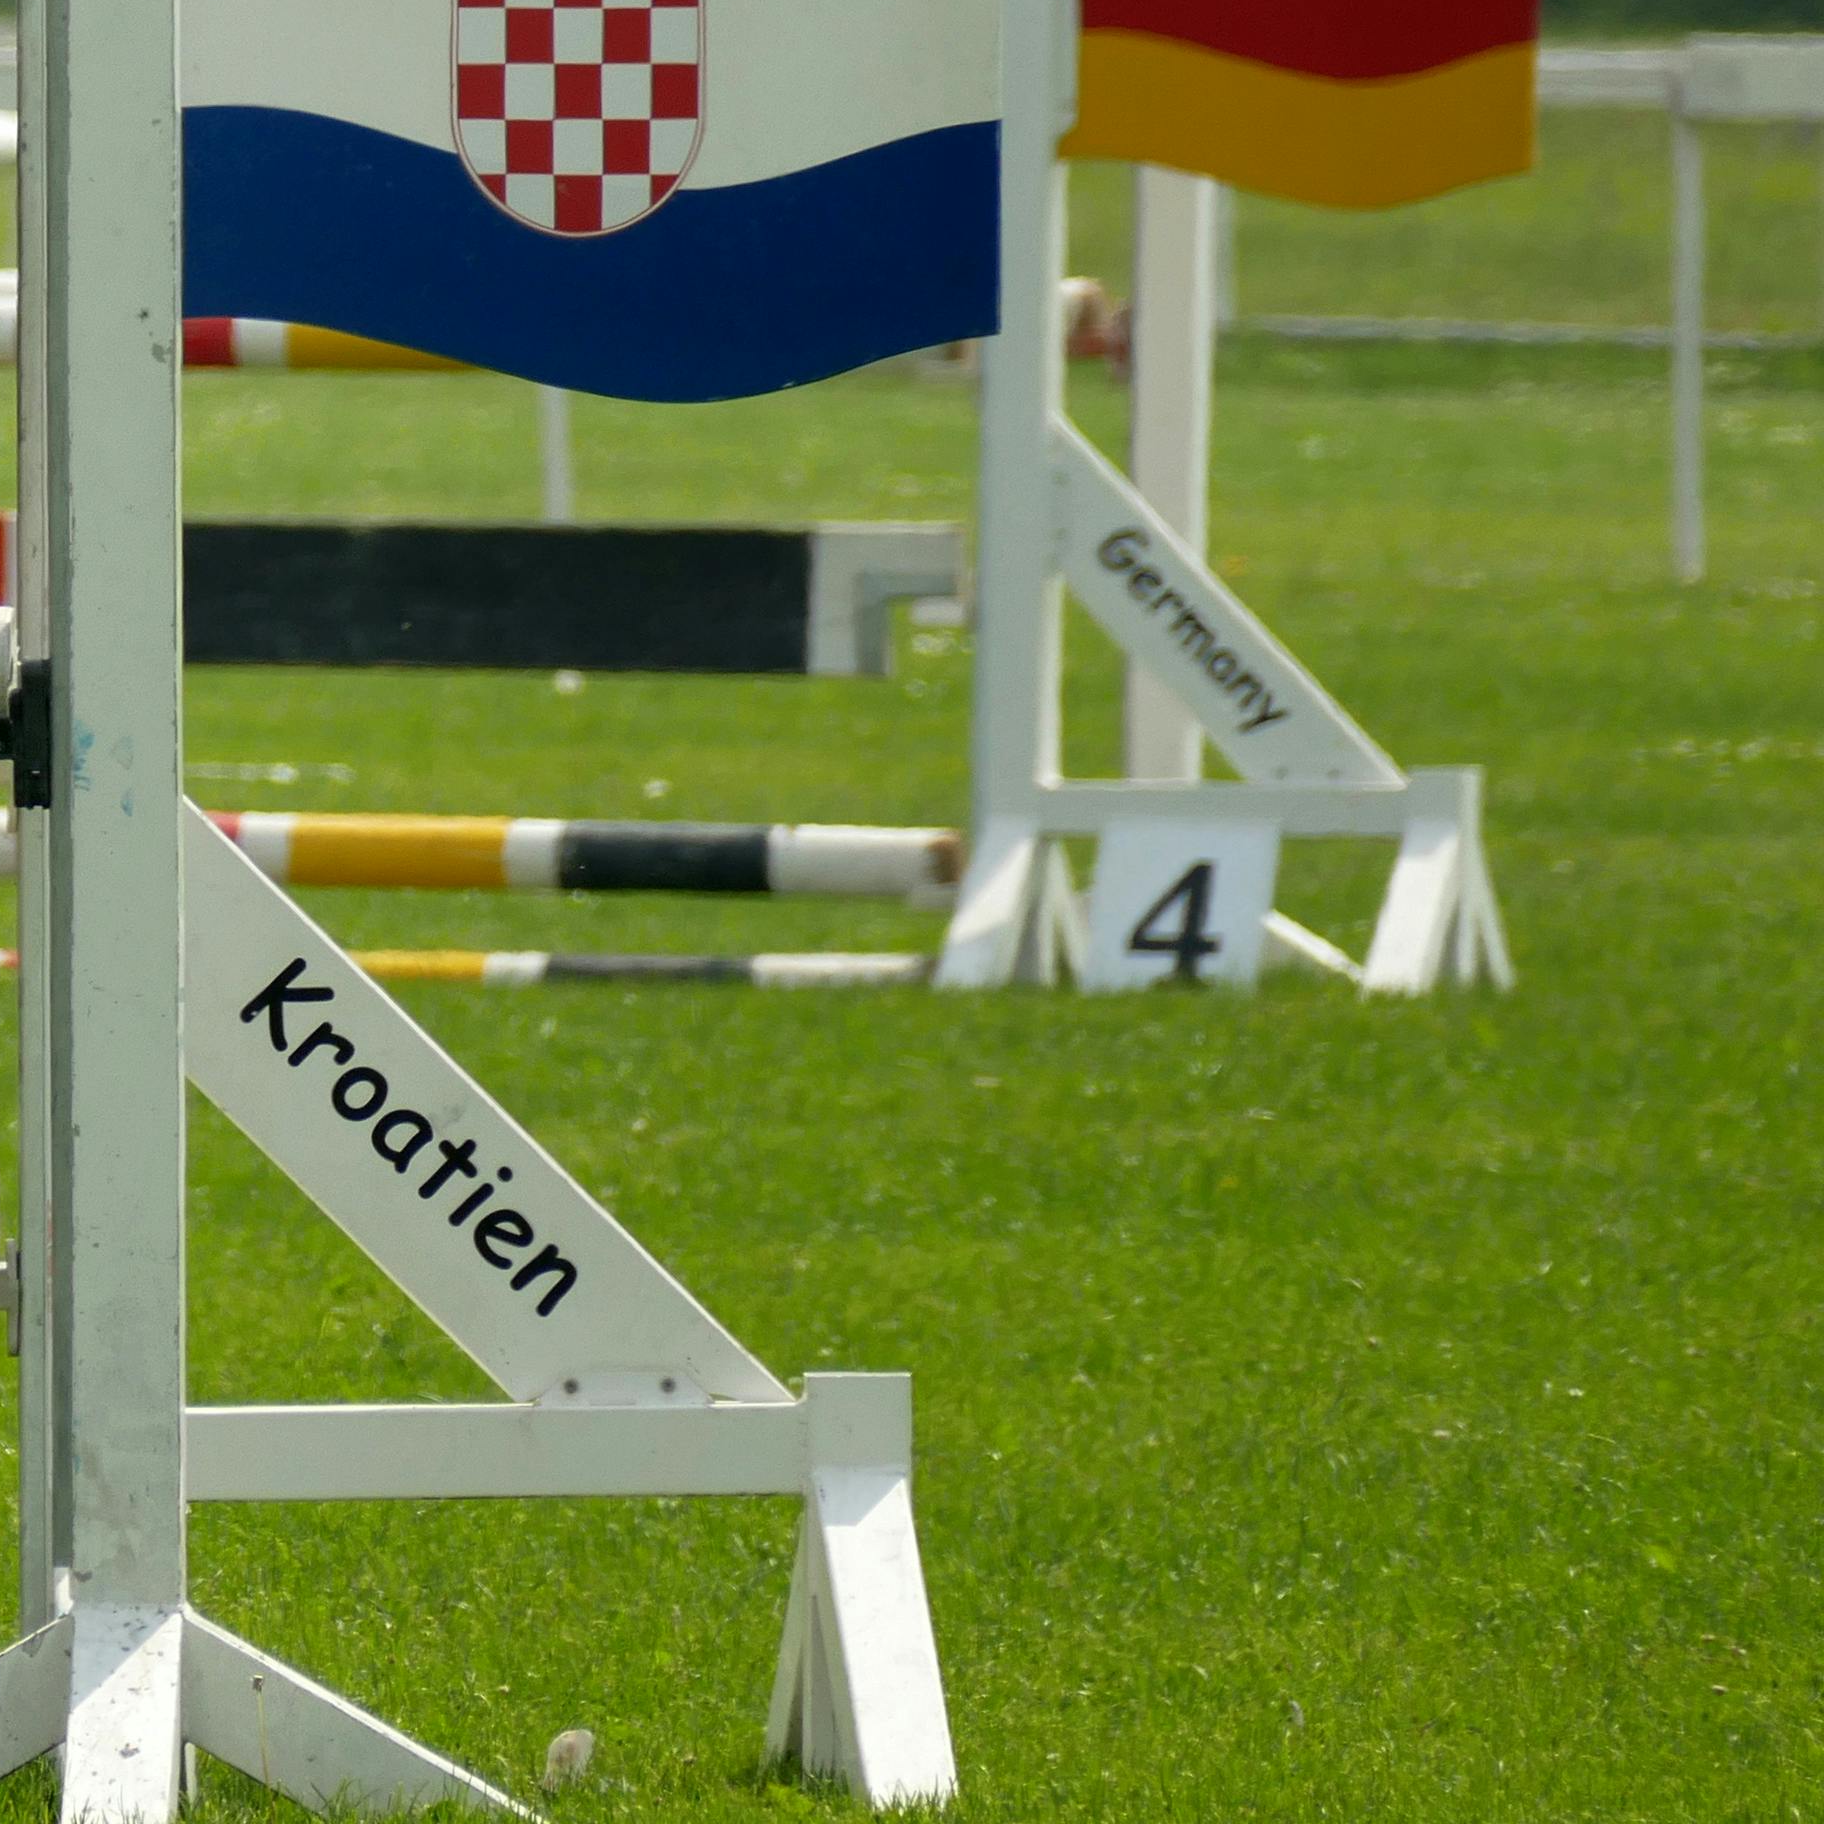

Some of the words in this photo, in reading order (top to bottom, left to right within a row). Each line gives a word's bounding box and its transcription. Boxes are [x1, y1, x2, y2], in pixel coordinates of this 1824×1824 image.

[1097, 527, 1289, 733] Germany
[1127, 861, 1220, 983] 4
[240, 957, 579, 1317] Kroatien
